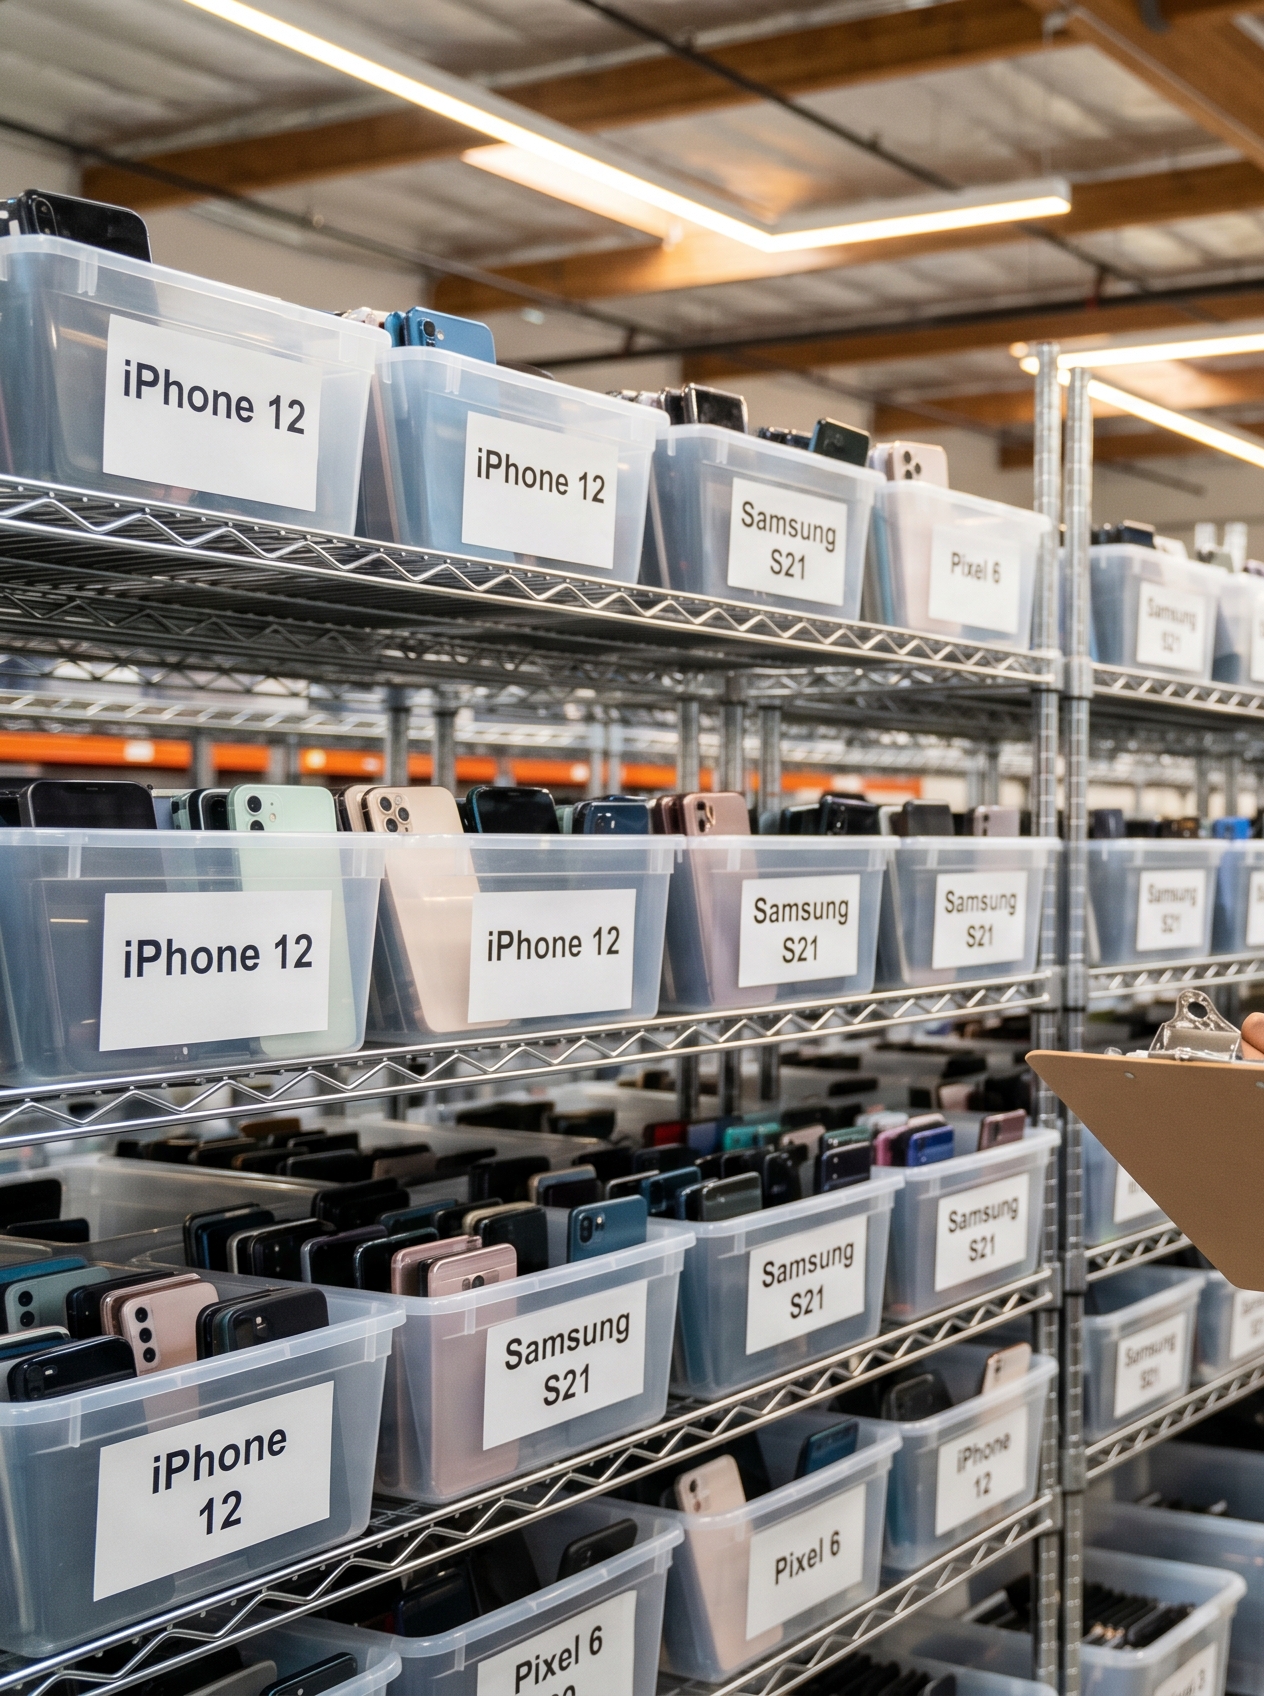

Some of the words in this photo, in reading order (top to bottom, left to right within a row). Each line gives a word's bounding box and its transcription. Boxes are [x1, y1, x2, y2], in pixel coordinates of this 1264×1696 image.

[124, 359, 254, 423] iPhone
[269, 395, 305, 434] 12
[477, 447, 568, 495] iPhone
[579, 472, 604, 503] 12
[741, 501, 838, 553] Samsung
[770, 549, 804, 579] S21
[951, 552, 986, 580] Pixel
[991, 562, 1002, 585] 6
[754, 897, 848, 925] Samsung
[945, 890, 1016, 916] Samsung
[125, 939, 260, 978] iPhone
[275, 934, 312, 969] 12
[488, 930, 582, 961] iPhone
[593, 926, 619, 955] 12
[783, 936, 817, 963] S21
[966, 925, 992, 948] S21
[947, 1196, 1020, 1235] Samsung
[761, 1240, 856, 1290] Samsung
[969, 1235, 994, 1262] S21
[790, 1285, 823, 1319] S21
[504, 1310, 632, 1371] Samsung
[542, 1365, 592, 1407] S21
[151, 1426, 288, 1495] iPhone
[956, 1430, 1012, 1475] iPhone
[974, 1471, 991, 1498] 12
[199, 1489, 242, 1536] 12
[775, 1540, 825, 1586] Pixel
[830, 1530, 840, 1556] 6
[515, 1634, 580, 1695] Pixel
[589, 1626, 602, 1655] 6
